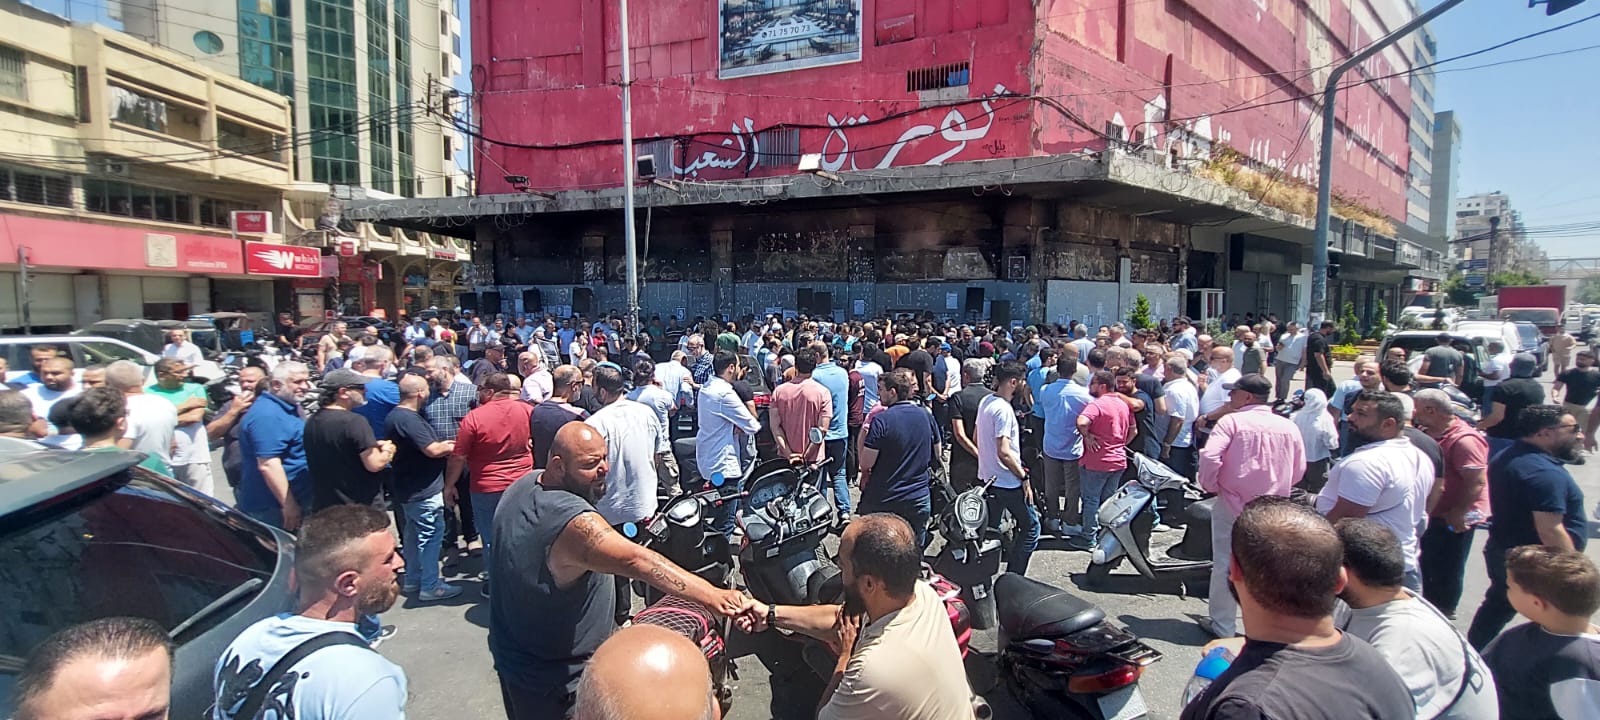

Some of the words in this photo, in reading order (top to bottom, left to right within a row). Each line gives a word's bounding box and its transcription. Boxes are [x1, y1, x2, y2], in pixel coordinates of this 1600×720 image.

[768, 29, 777, 37] 71
[790, 26, 799, 34] 70
[669, 116, 759, 178] الشعب
[294, 253, 319, 264] whish
